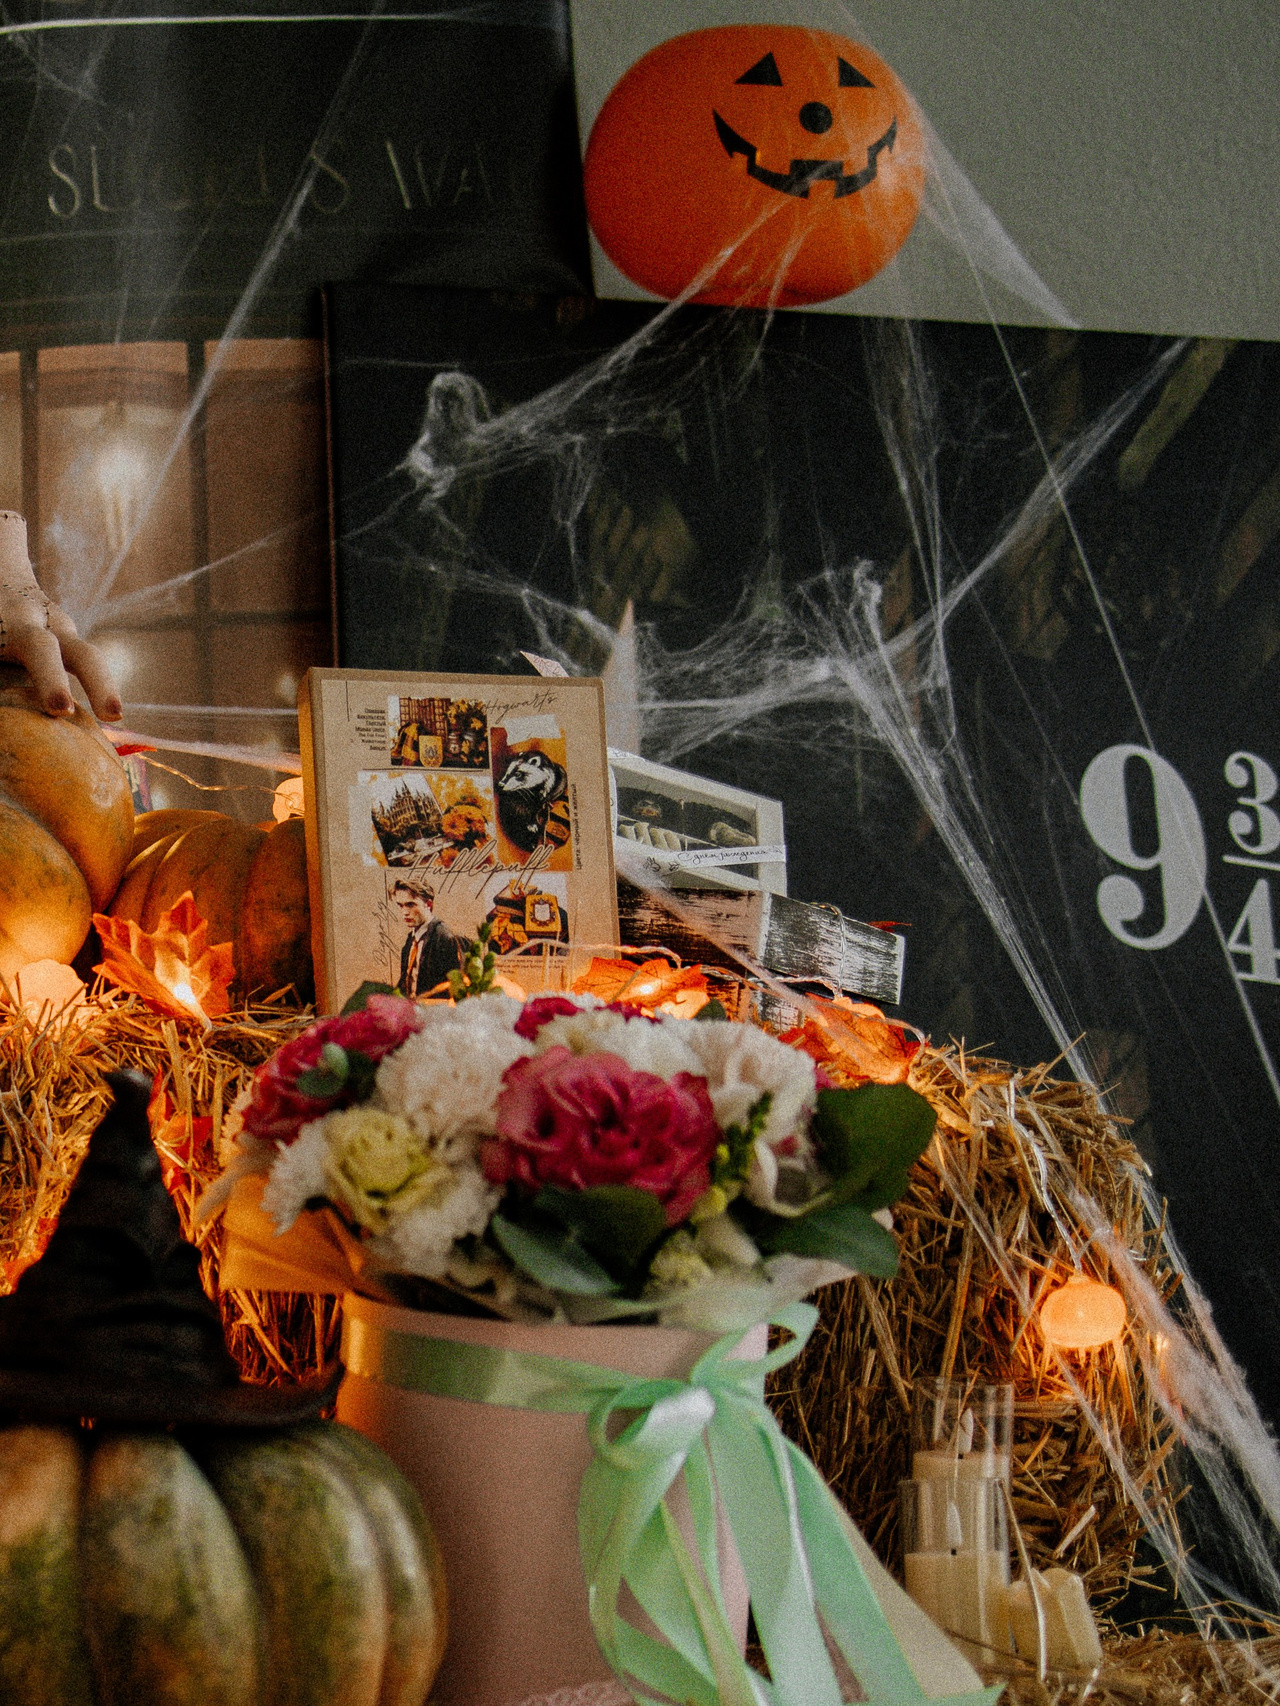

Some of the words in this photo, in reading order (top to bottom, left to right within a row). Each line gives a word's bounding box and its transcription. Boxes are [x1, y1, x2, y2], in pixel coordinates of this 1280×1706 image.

[1080, 743, 1207, 950] 9
[1224, 751, 1280, 855] 3
[407, 839, 555, 900] Hufflepuff
[1228, 878, 1280, 986] 4
